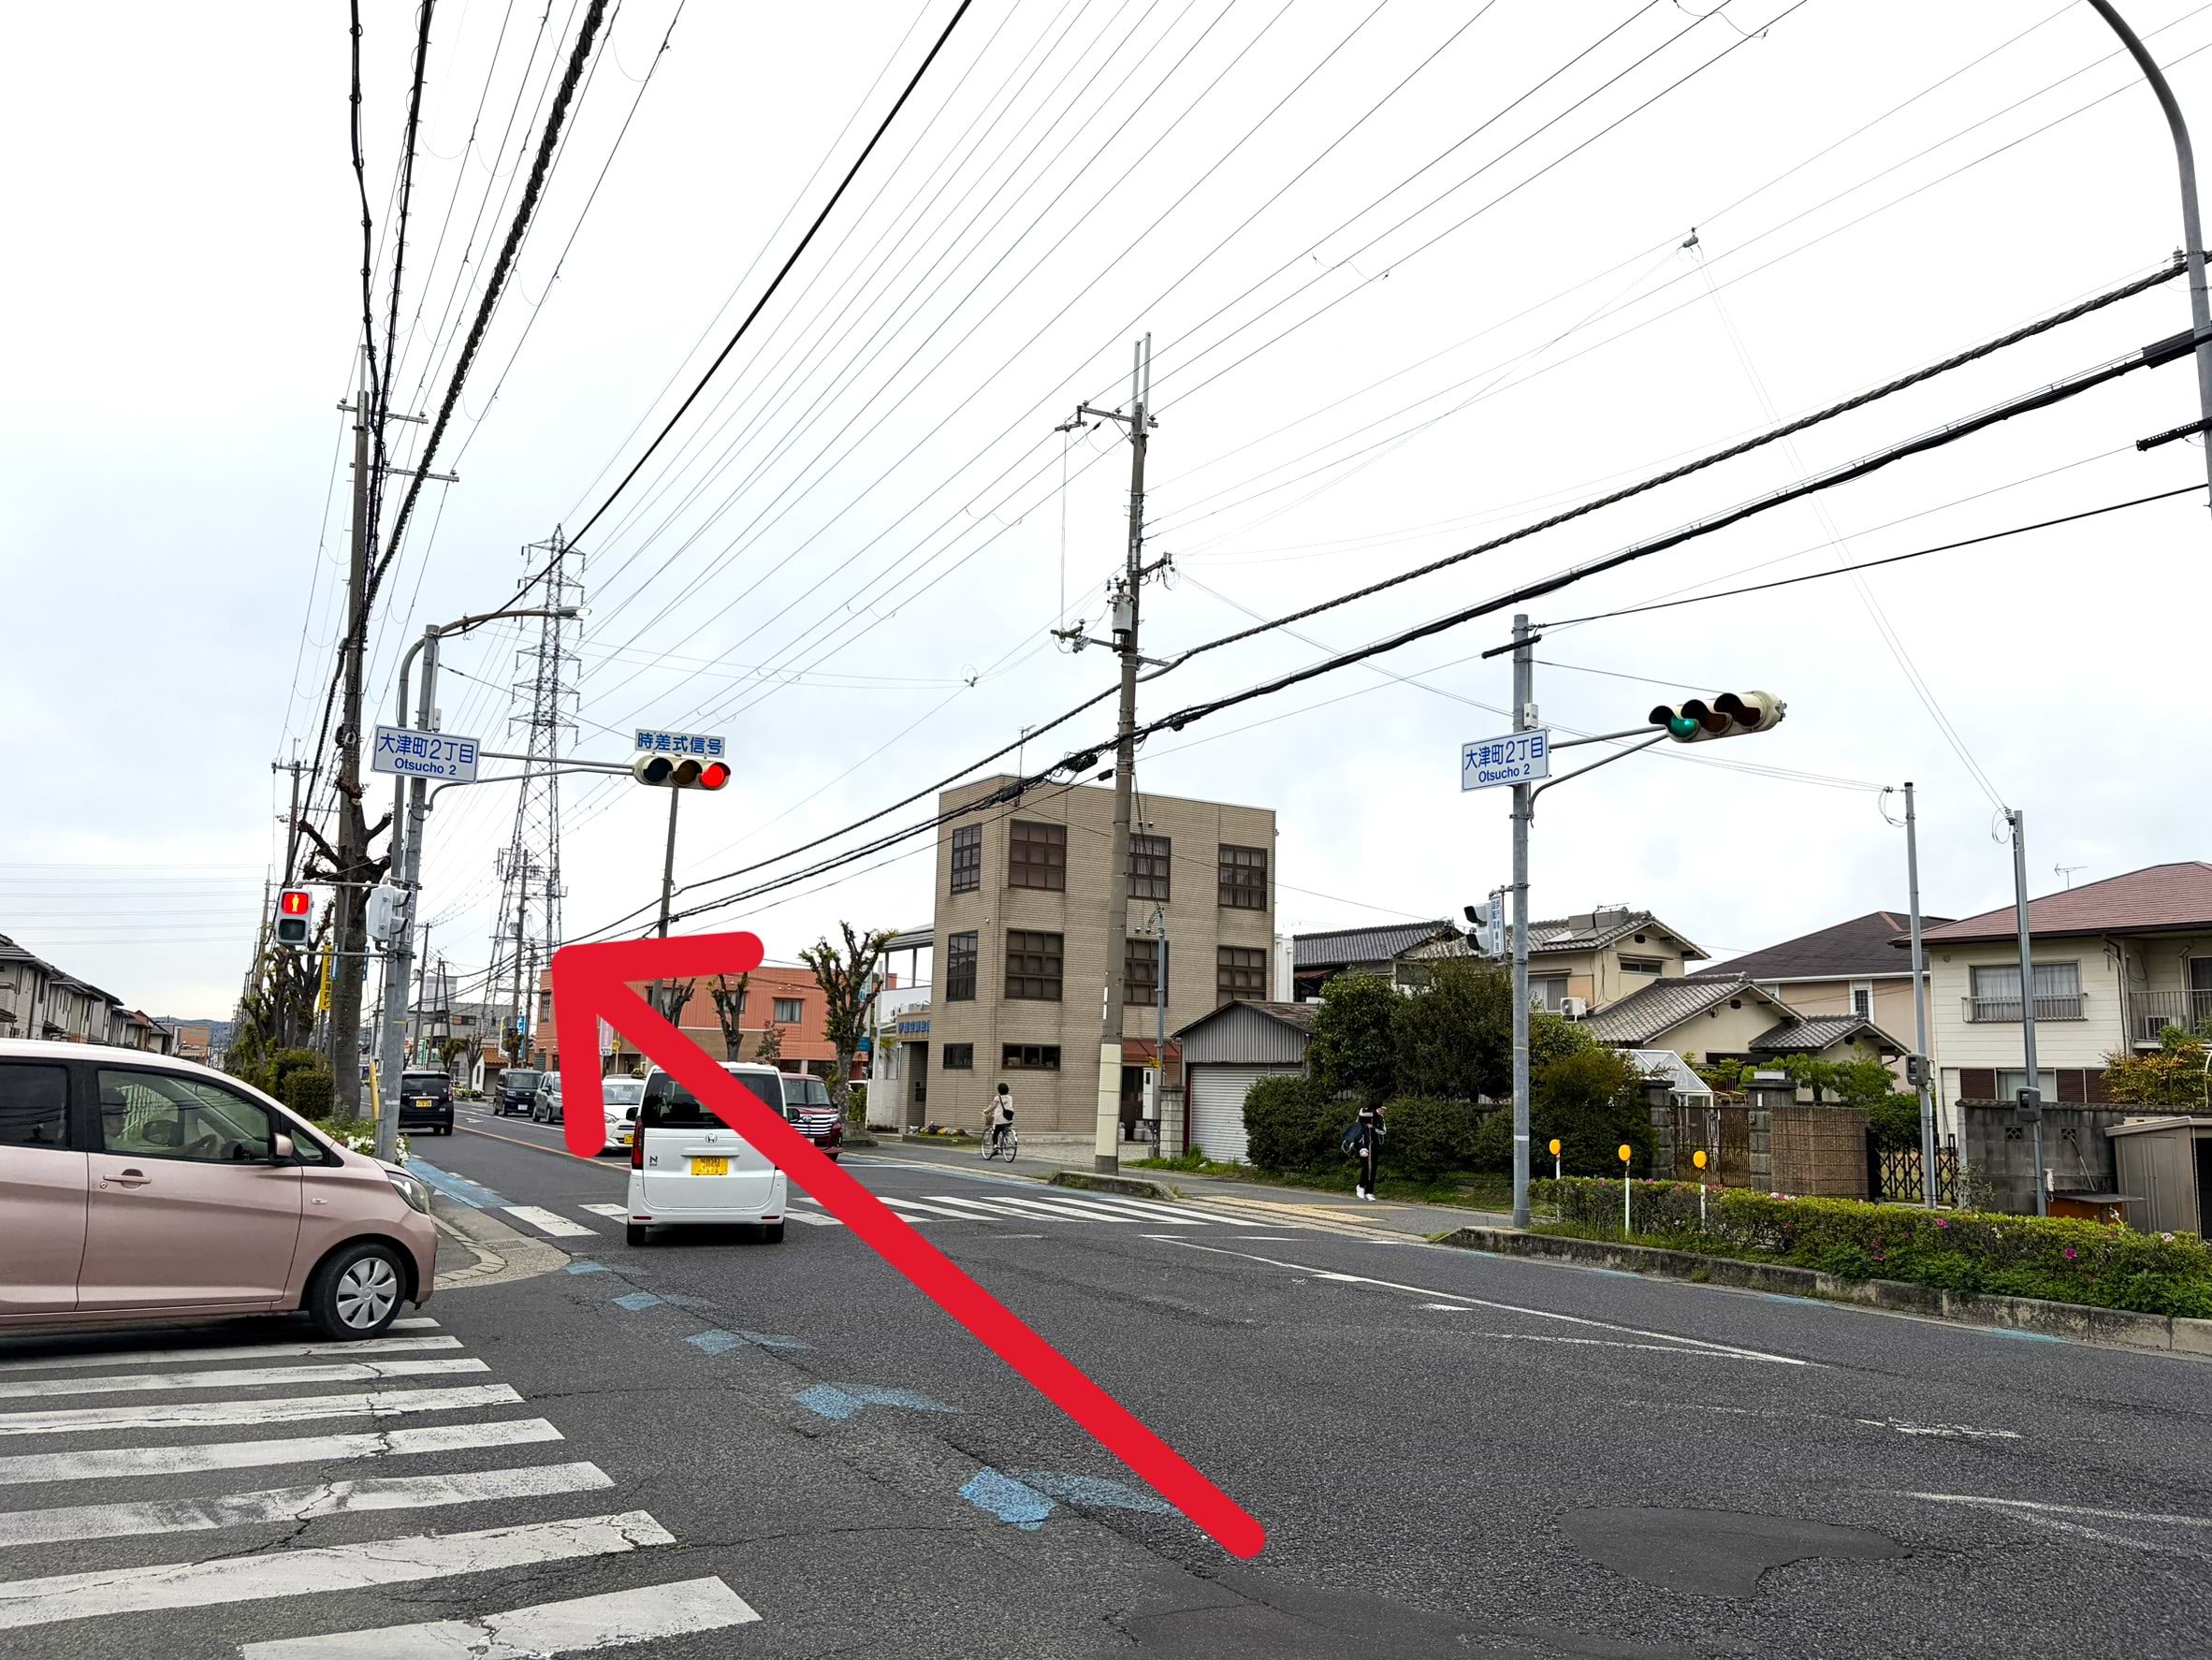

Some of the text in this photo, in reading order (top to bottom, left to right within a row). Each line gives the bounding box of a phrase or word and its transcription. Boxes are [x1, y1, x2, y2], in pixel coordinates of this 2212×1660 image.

[378, 733, 474, 764] 大津町2丁目
[637, 732, 722, 755] 時差式信号
[1464, 735, 1544, 771] 大津町2丁目
[394, 757, 457, 776] Otsucho 2
[1478, 763, 1531, 783] Otsucho 2
